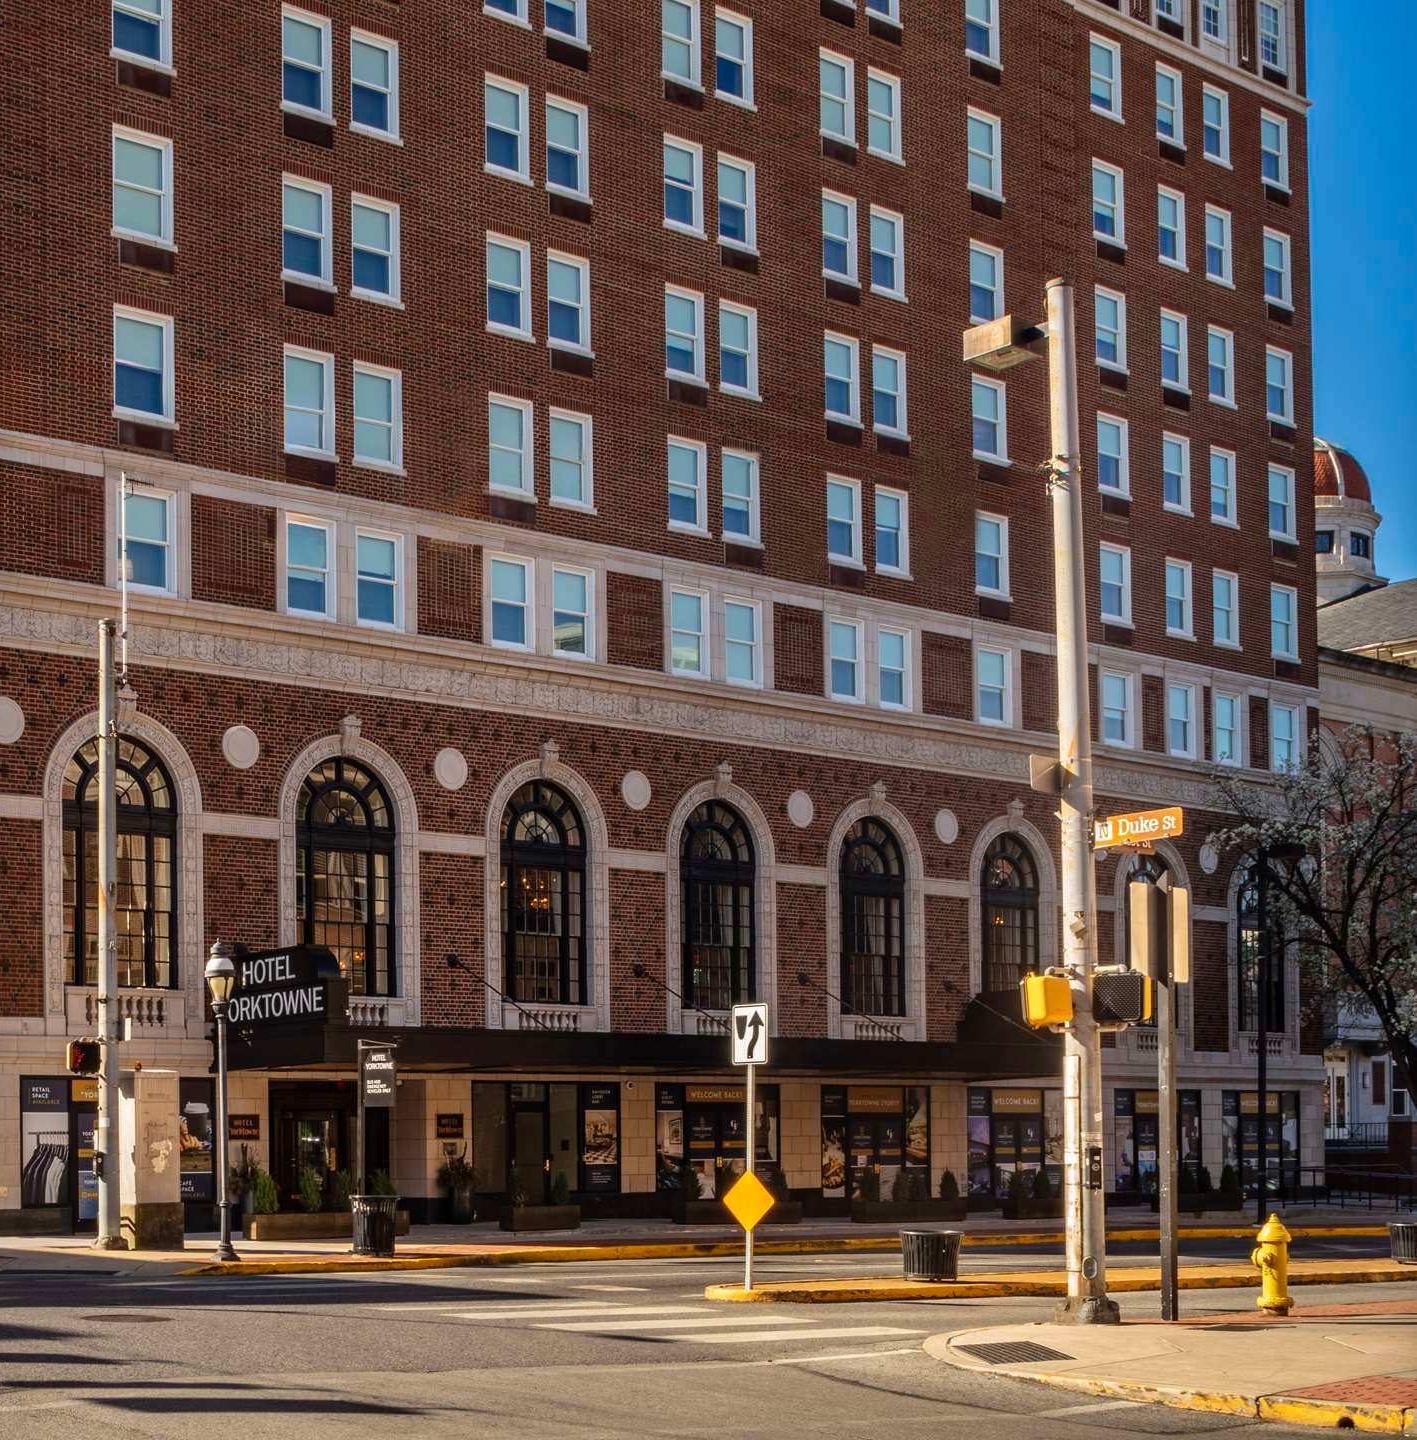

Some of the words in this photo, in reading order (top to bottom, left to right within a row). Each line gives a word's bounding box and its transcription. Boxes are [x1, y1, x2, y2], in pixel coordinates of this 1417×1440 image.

[1098, 822, 1109, 839] N
[1118, 816, 1159, 836] Duke
[1162, 815, 1177, 830] St
[242, 955, 296, 986] HOTEL
[228, 986, 324, 1022] ORKTOWNE
[365, 1062, 394, 1070] YORKTOWNE
